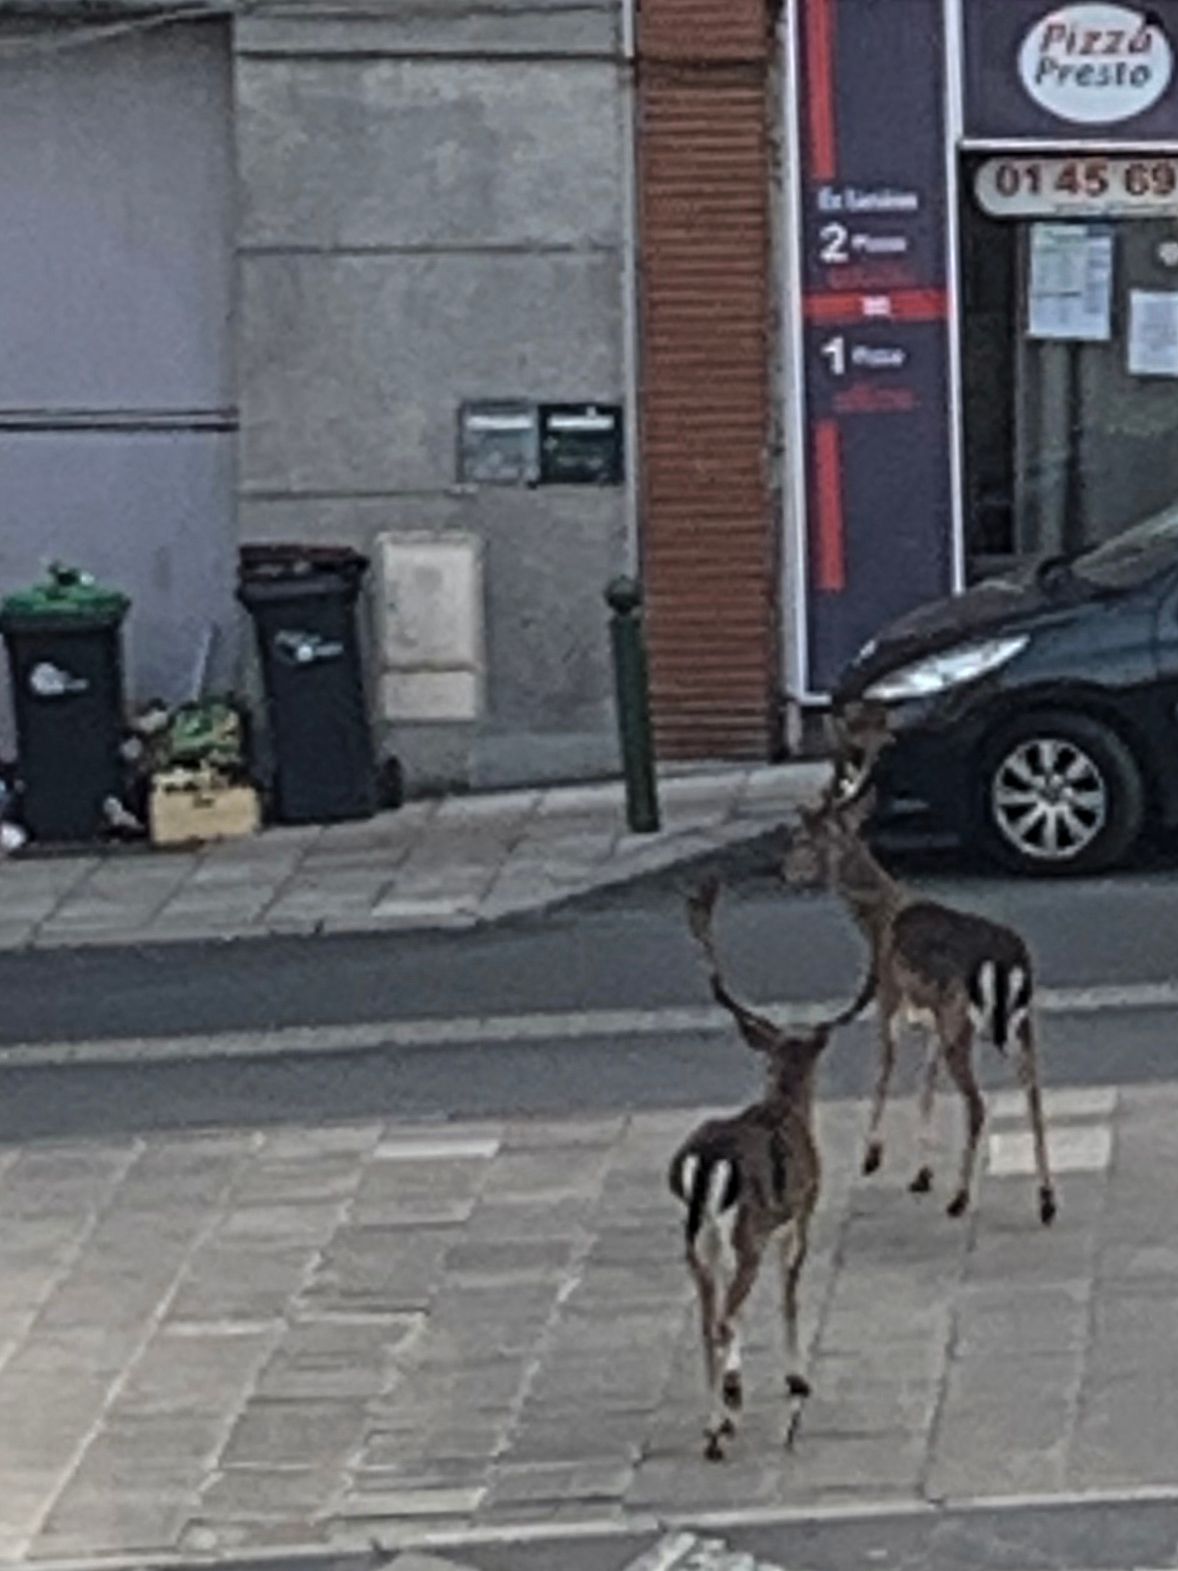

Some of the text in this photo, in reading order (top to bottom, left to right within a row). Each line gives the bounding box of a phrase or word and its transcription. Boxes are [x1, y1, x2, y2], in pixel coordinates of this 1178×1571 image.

[1040, 22, 1153, 55] Pizza
[1035, 57, 1153, 87] Presto
[996, 163, 1041, 197] 01
[1055, 163, 1108, 197] 45
[1123, 163, 1177, 197] 69
[819, 222, 849, 263] 2
[820, 336, 845, 375] 1
